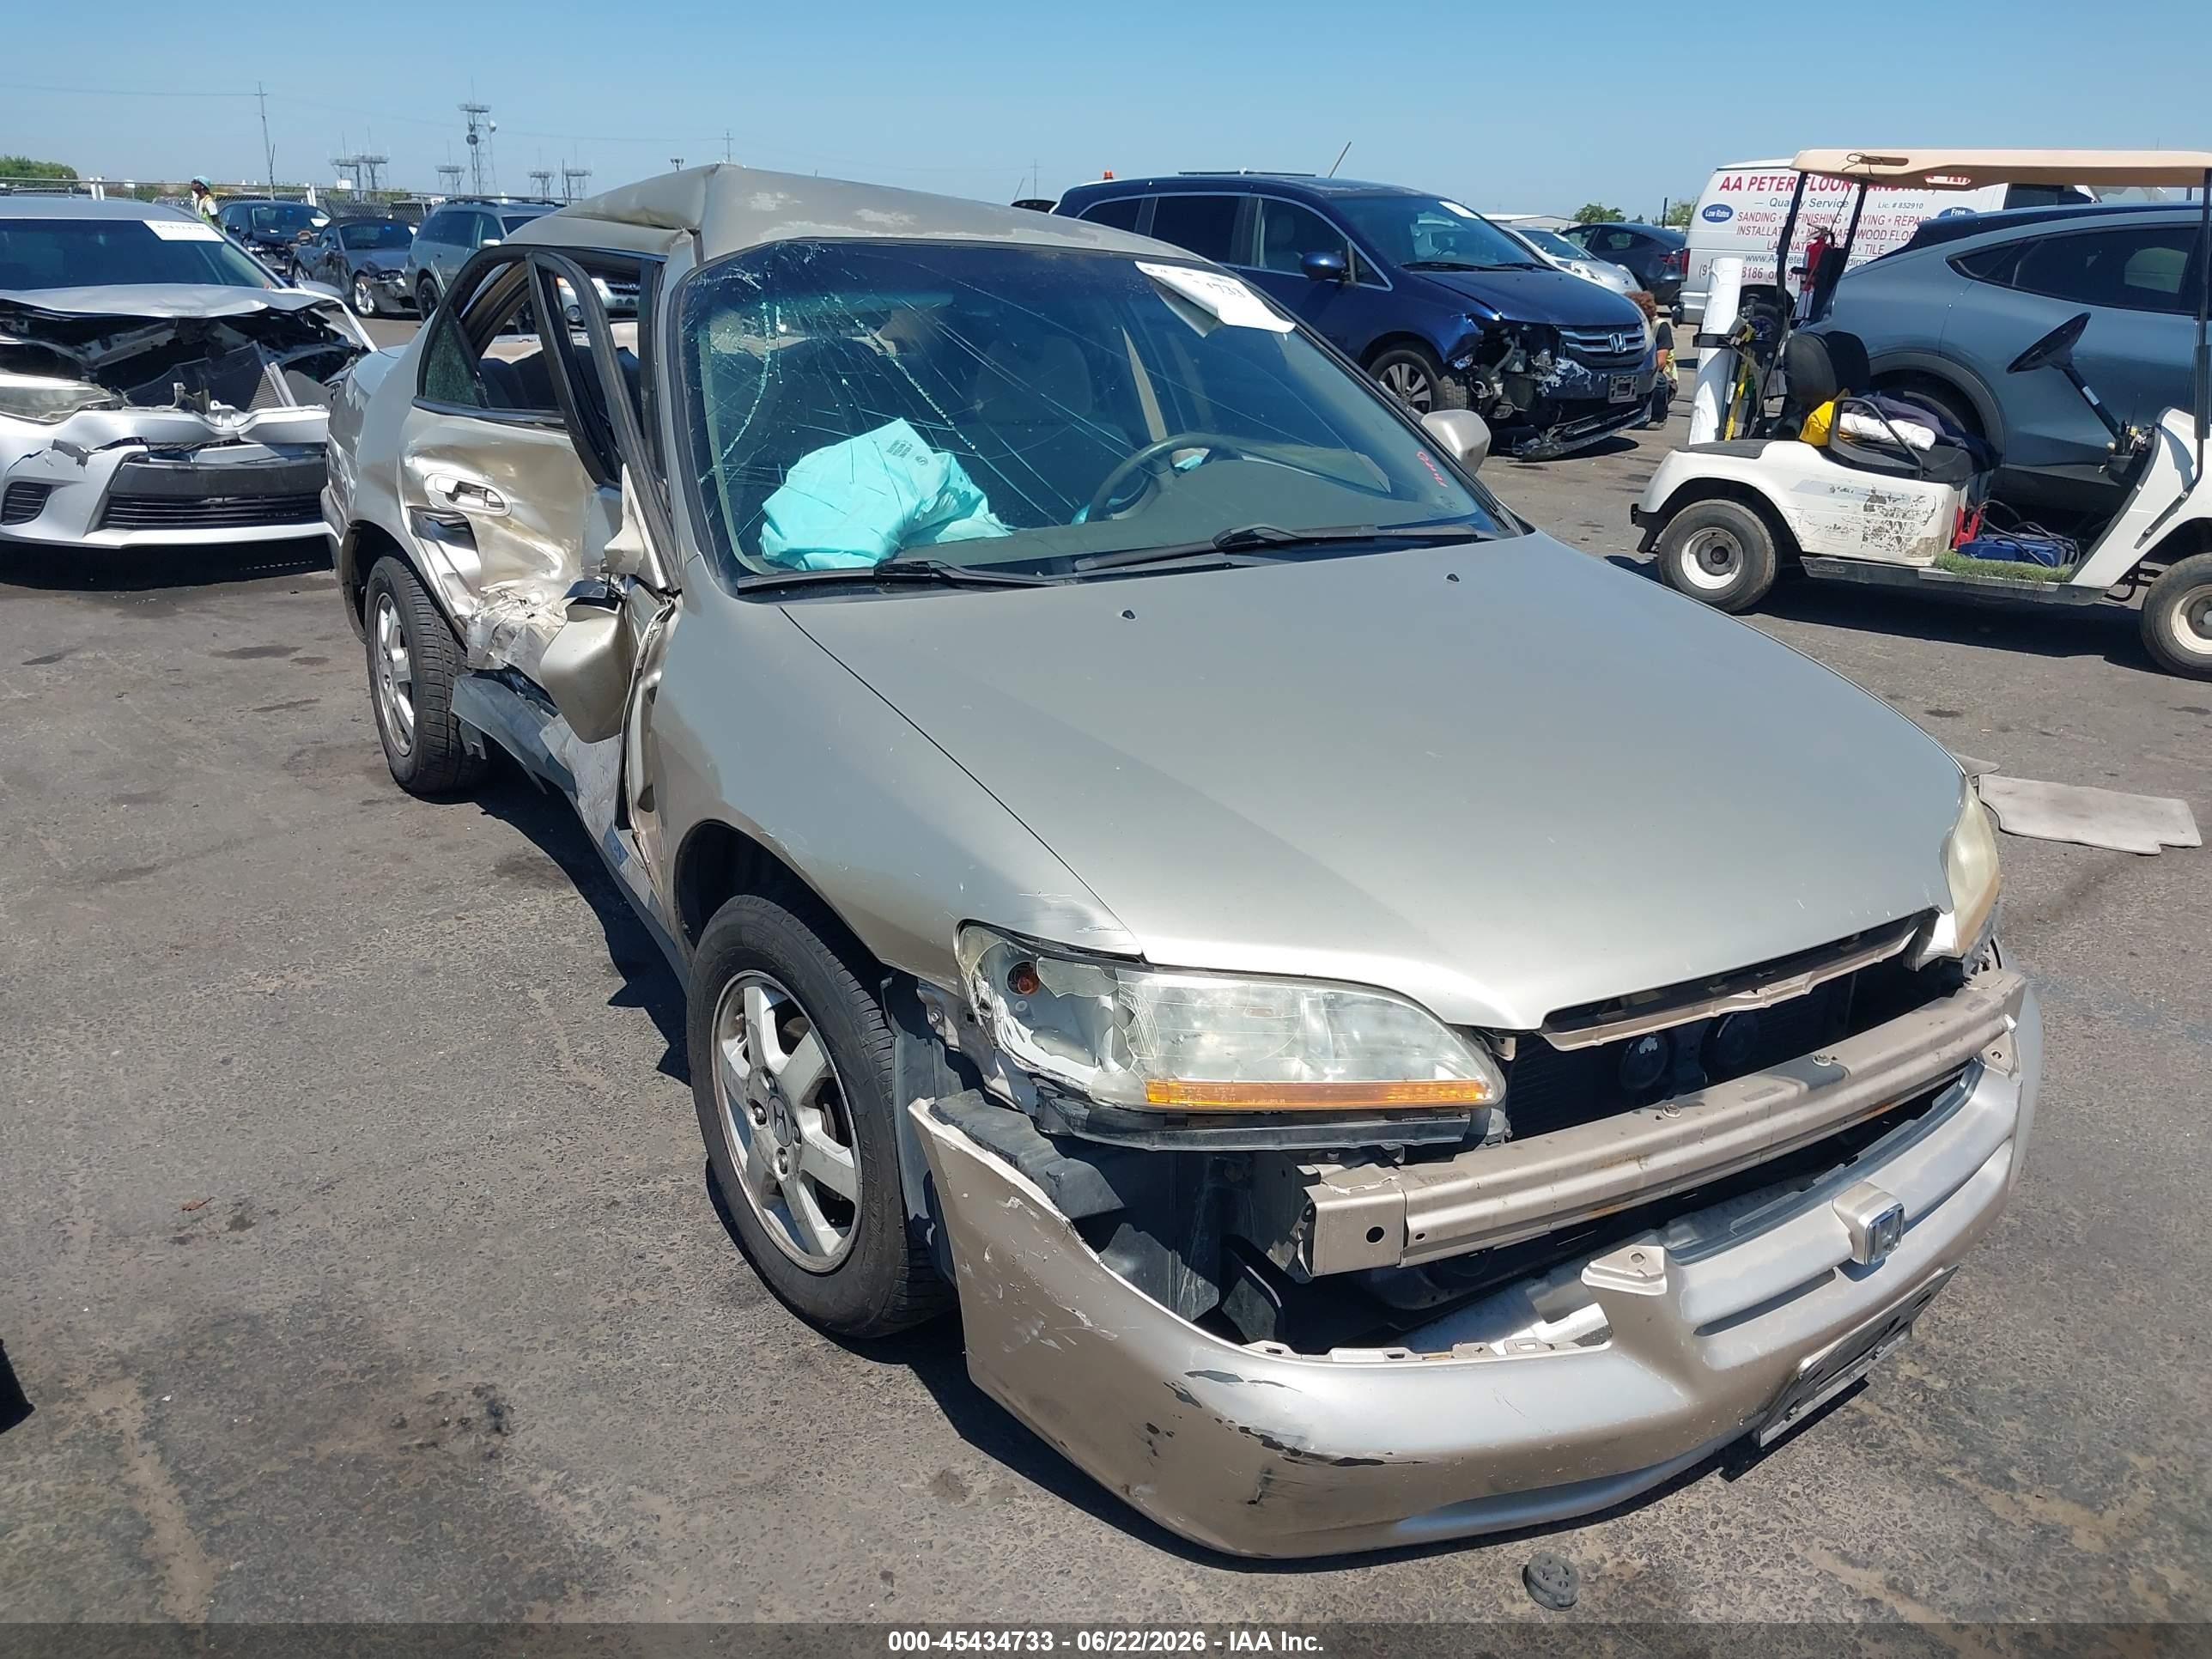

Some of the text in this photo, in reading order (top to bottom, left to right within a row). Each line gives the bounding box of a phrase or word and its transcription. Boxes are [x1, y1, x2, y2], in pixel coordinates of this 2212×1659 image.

[1719, 176, 1742, 191] AA
[1747, 176, 1796, 191] PETER
[1769, 198, 1850, 210] Quay Service
[1705, 209, 1730, 218] Low Rates
[1737, 211, 1777, 222] SANDING
[1784, 212, 1842, 224] FINISHING
[1856, 215, 1886, 226] AYING
[1736, 226, 1799, 237] INSTALLATN
[1865, 244, 1885, 255] TILE
